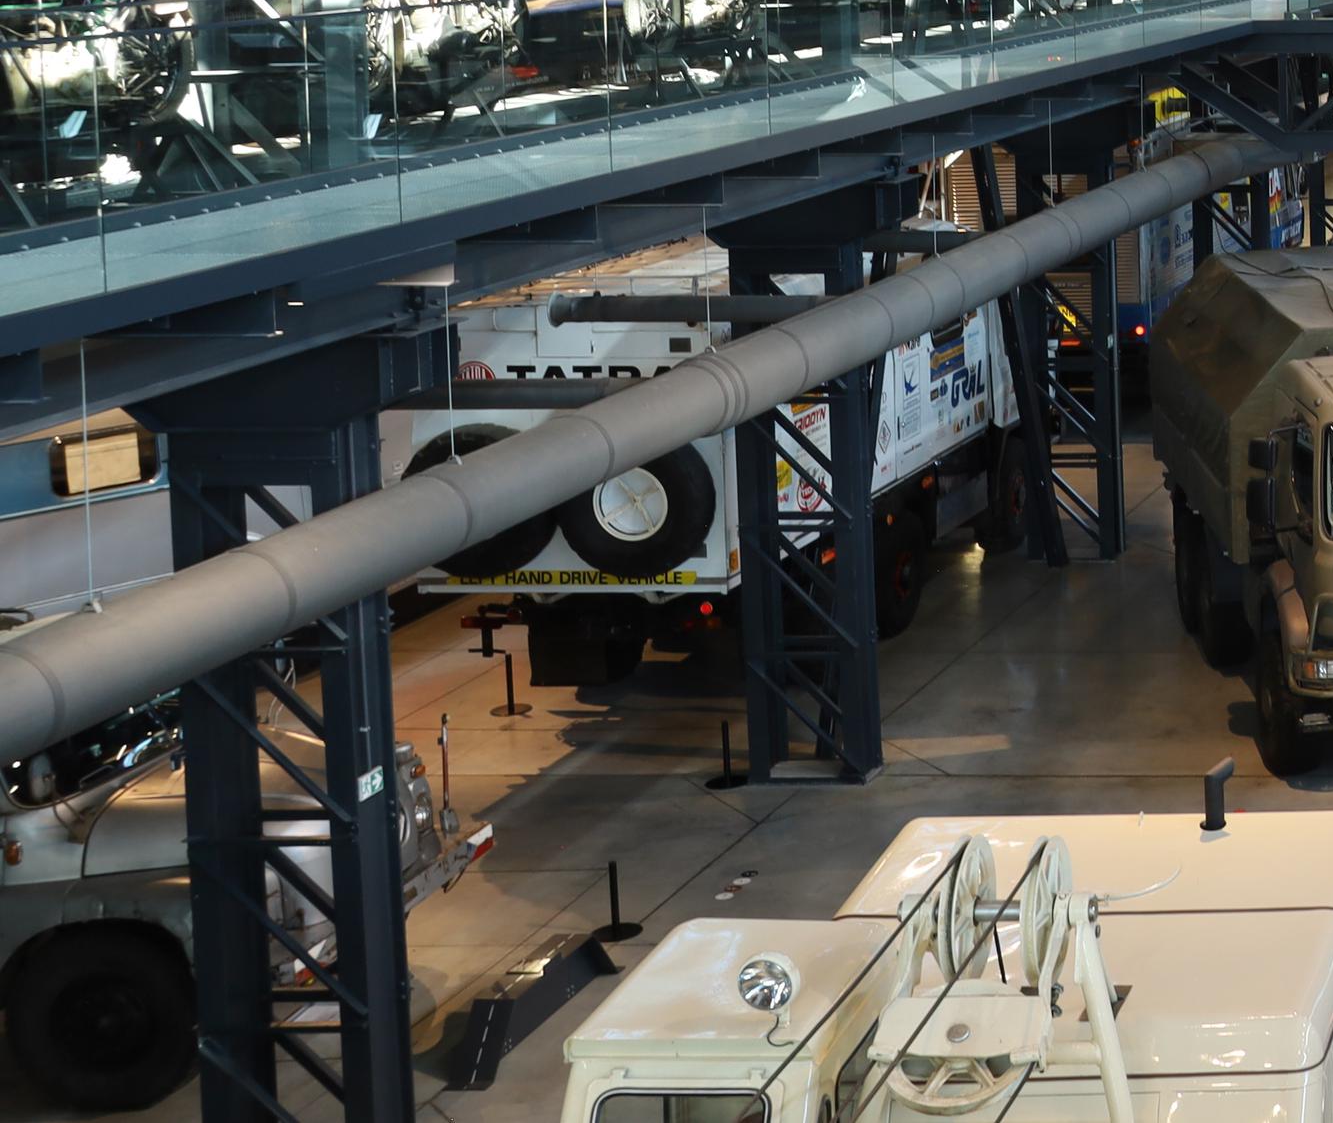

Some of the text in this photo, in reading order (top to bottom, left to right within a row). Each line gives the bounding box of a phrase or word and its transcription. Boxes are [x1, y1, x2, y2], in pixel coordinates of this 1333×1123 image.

[505, 571, 553, 585] HAND
[559, 571, 608, 585] DRIVE
[617, 572, 683, 585] VEHICLE
